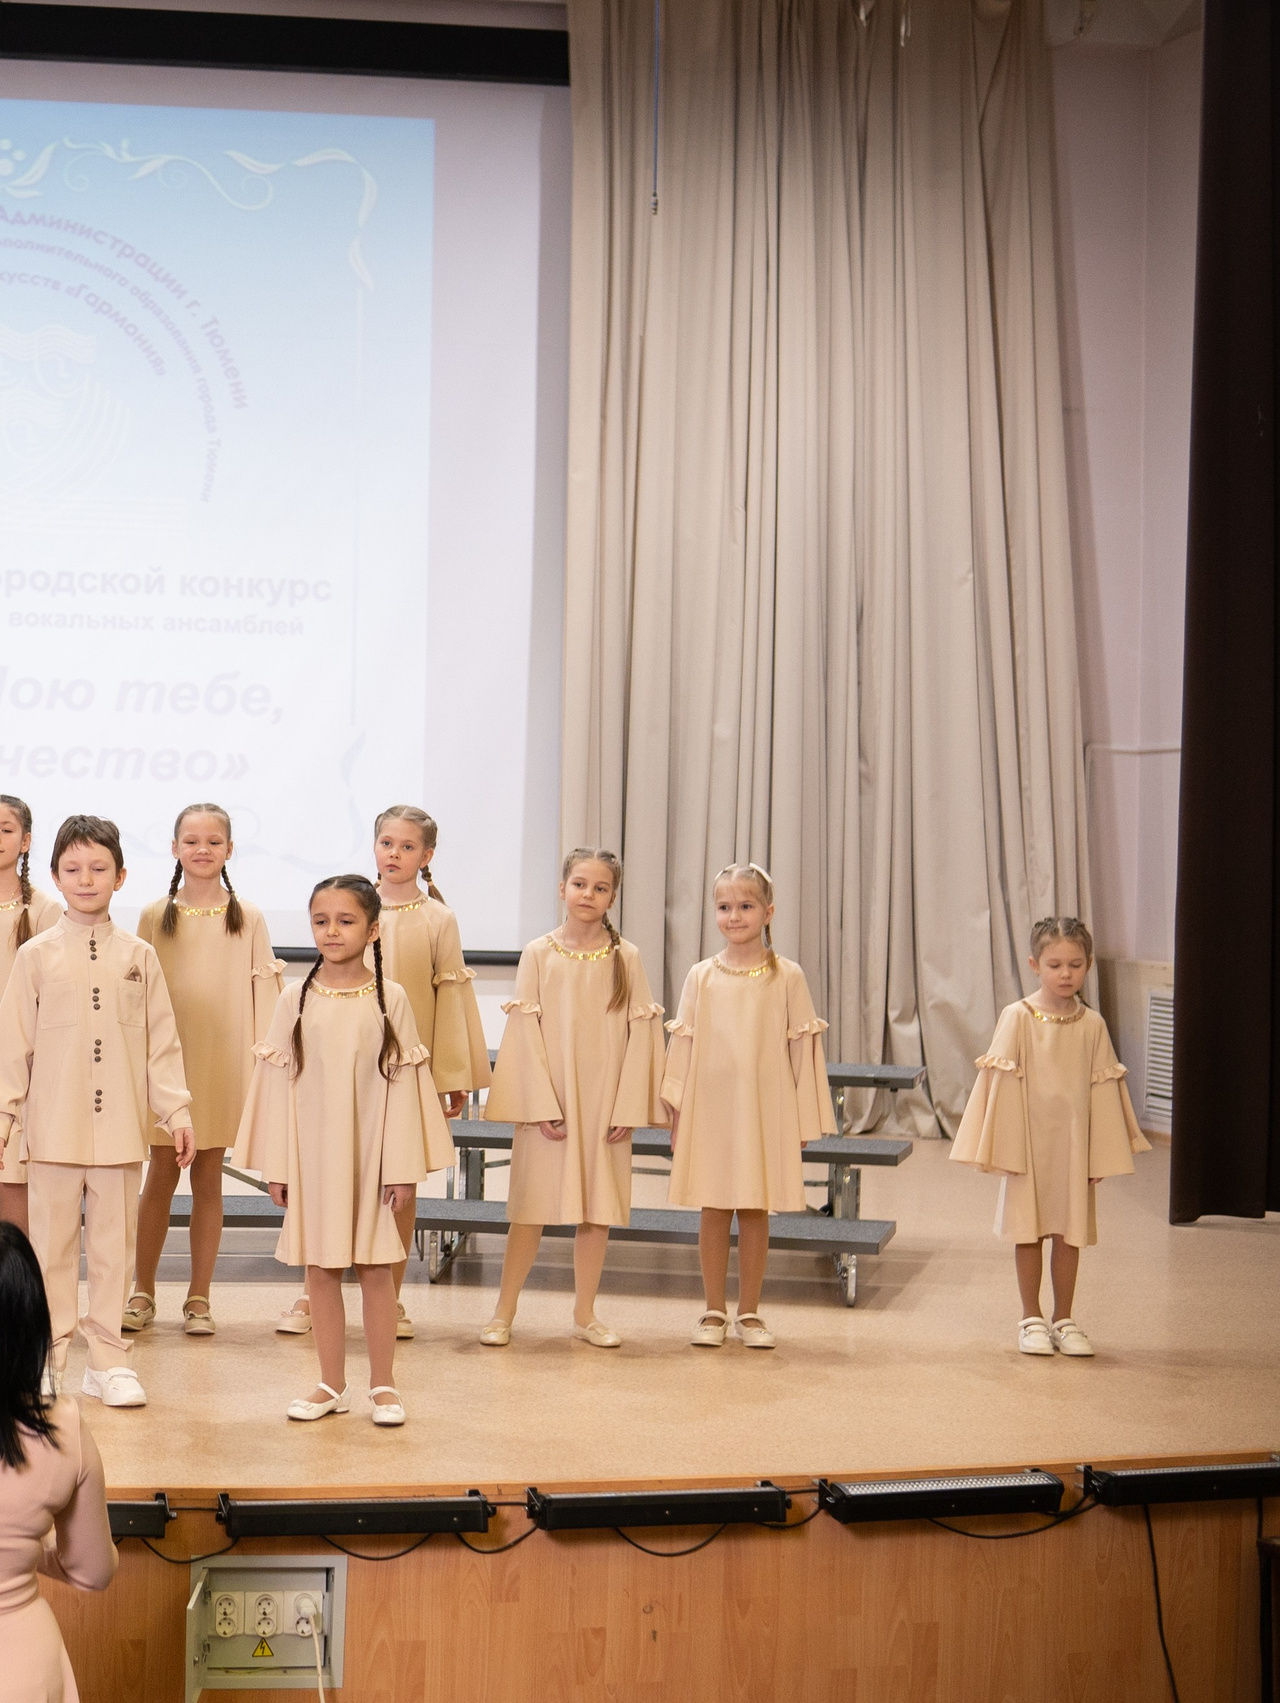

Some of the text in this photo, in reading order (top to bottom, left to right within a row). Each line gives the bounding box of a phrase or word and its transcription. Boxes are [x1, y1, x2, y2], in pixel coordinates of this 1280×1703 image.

[64, 282, 167, 377] «Гармония»
[129, 285, 203, 375] образования
[185, 299, 201, 318] г.
[201, 315, 249, 410] Тюмени
[196, 377, 218, 434] города
[199, 437, 221, 503] Тюмени
[178, 573, 333, 608] конкурс
[8, 610, 155, 632] вокальных
[161, 614, 305, 637] ансамблей
[113, 670, 284, 725] тебе,
